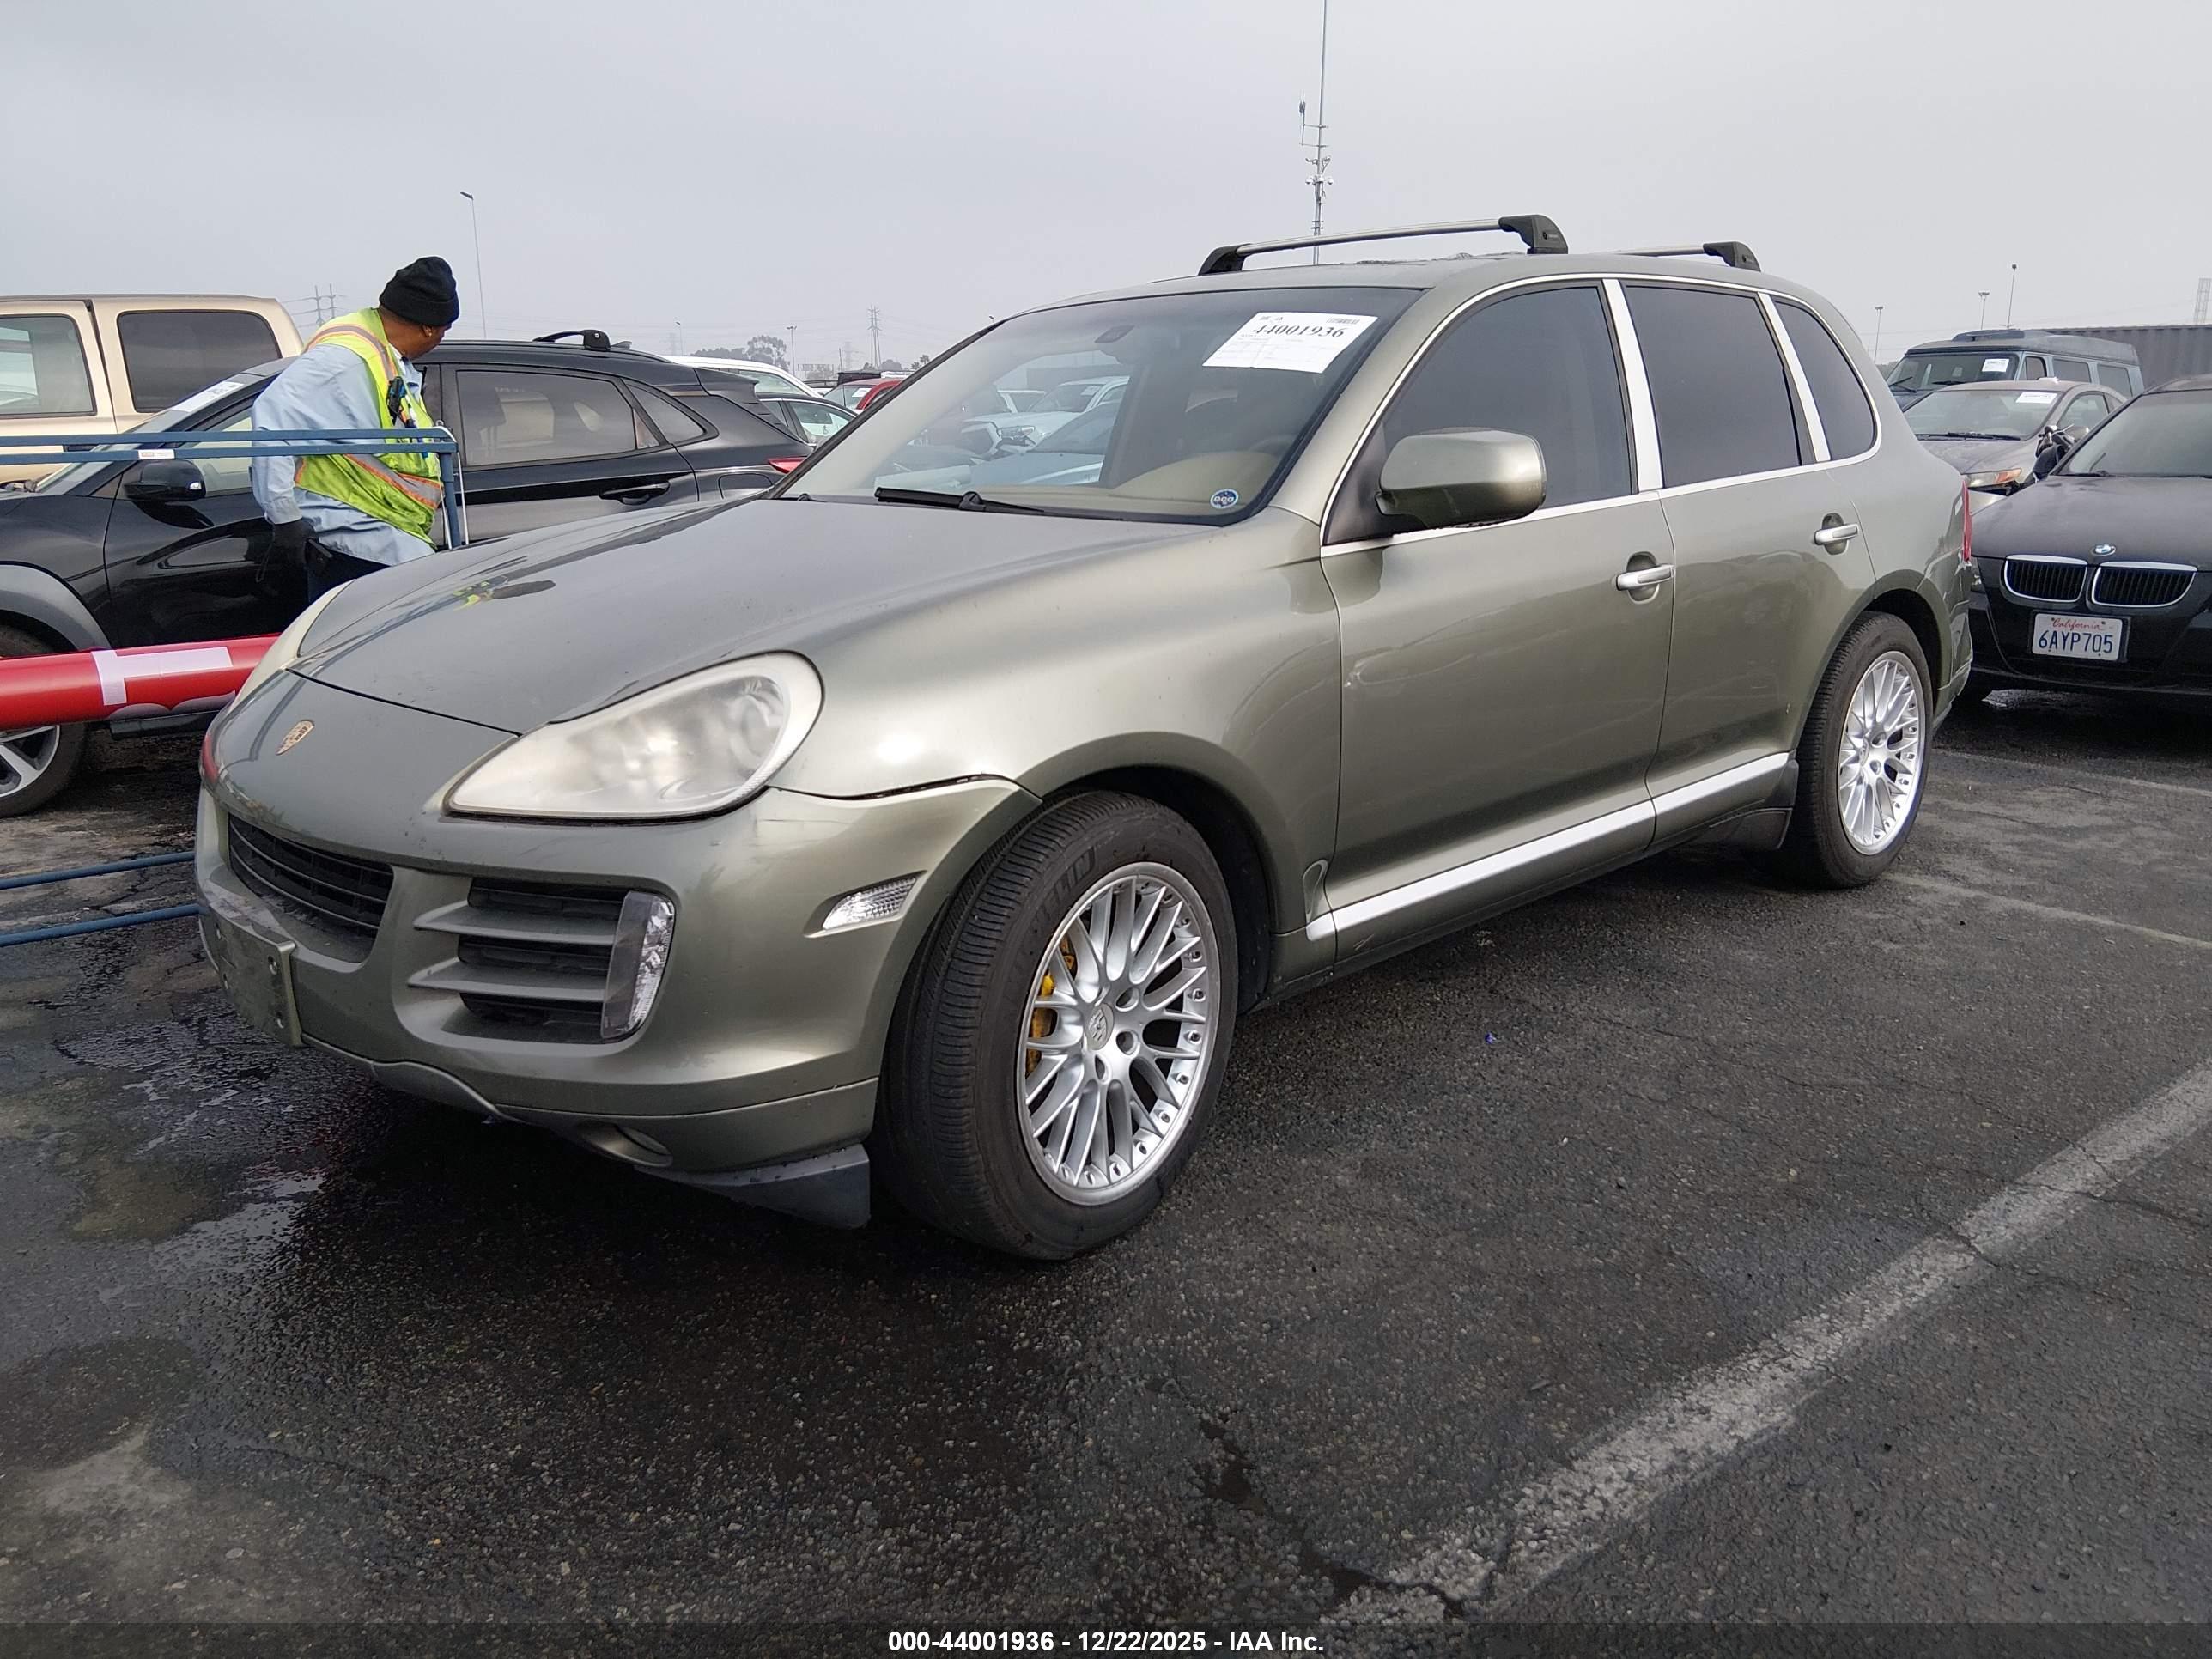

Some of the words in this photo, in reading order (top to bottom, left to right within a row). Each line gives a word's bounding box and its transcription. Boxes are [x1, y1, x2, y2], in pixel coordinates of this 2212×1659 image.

[1253, 324, 1348, 337] 44001936
[2052, 618, 2101, 630] California
[2039, 630, 2113, 653] 6AYP705
